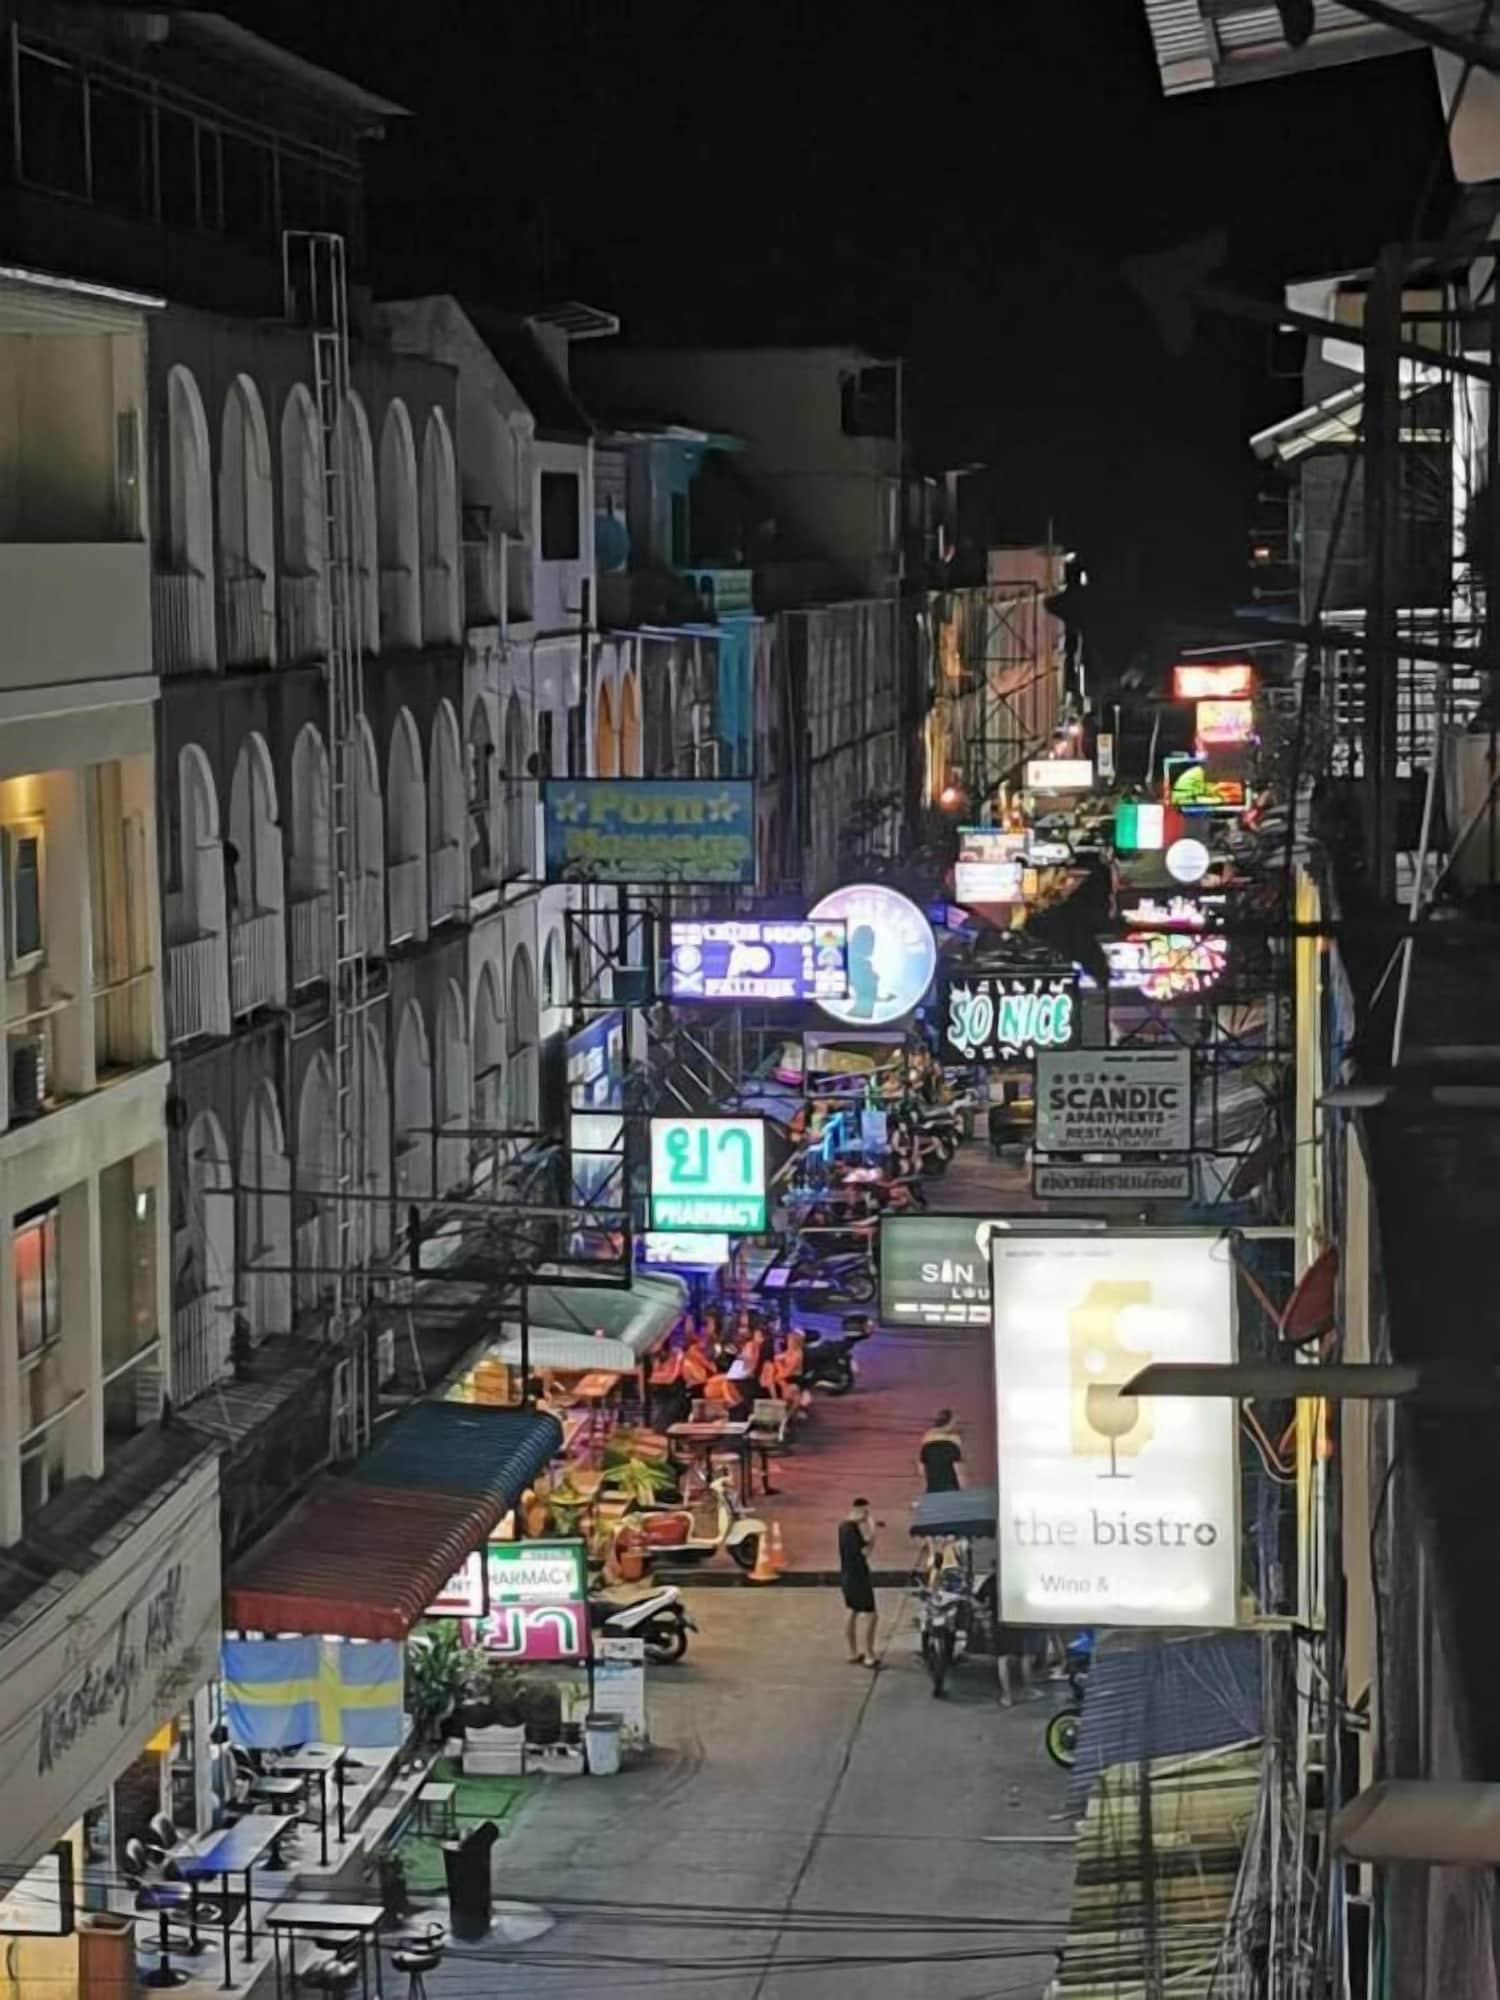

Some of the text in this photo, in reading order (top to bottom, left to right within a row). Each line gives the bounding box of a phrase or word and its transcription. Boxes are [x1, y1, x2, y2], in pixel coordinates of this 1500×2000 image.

[947, 992, 1072, 1050] SO NICE
[1050, 1088, 1178, 1110] SCANDIC
[1066, 1111, 1165, 1124] APARTMENTS
[1066, 1127, 1161, 1139] RESTAURANT
[666, 1127, 753, 1184] ยา
[655, 1200, 763, 1228] PHARMACY
[951, 1286, 990, 1300] LOU
[1013, 1507, 1217, 1547] the bistro
[490, 1567, 571, 1585] HARMACY
